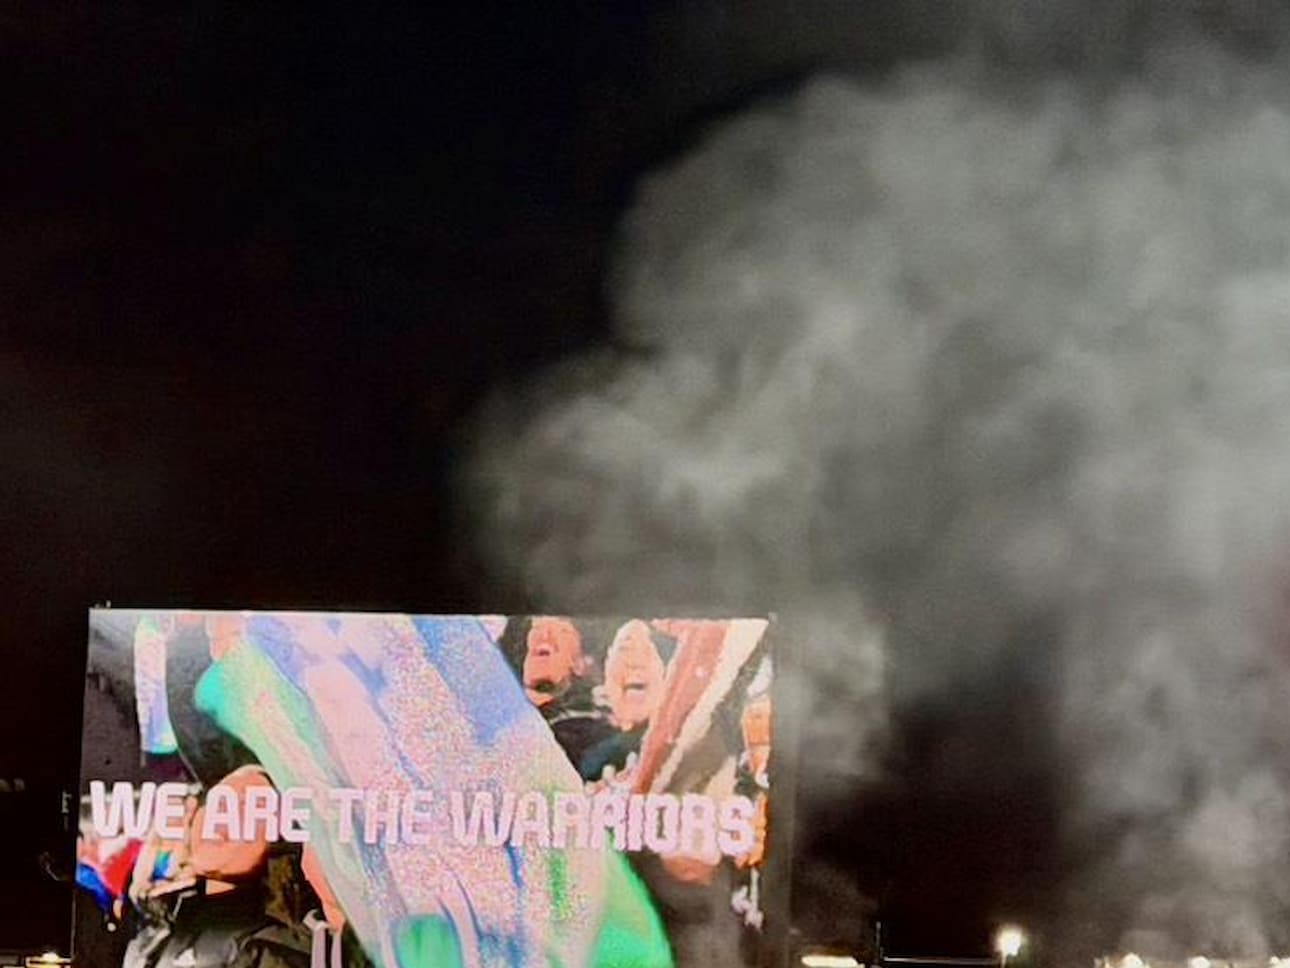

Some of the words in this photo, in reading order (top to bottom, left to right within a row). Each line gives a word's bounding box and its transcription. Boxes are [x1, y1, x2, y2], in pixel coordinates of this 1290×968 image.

[90, 780, 187, 839] WE
[202, 785, 311, 842] ARE
[329, 787, 433, 845] THE
[451, 791, 756, 856] WARRIORS
